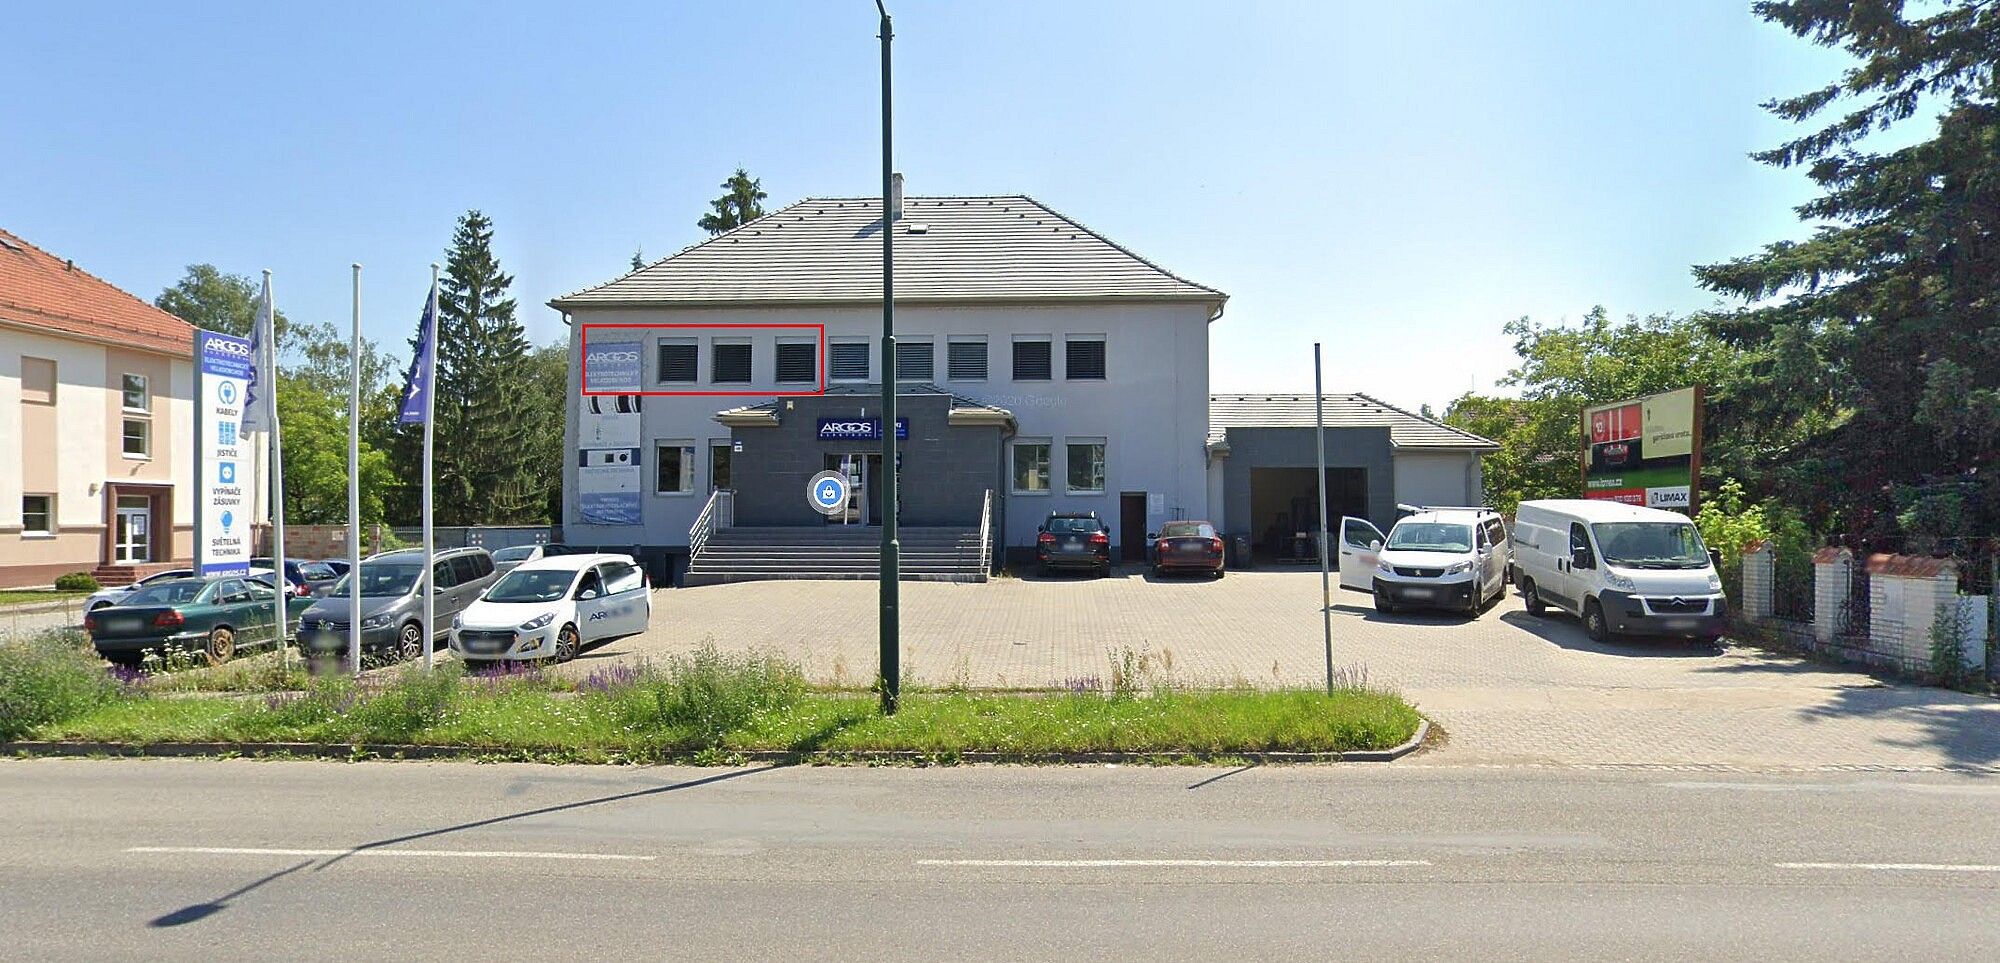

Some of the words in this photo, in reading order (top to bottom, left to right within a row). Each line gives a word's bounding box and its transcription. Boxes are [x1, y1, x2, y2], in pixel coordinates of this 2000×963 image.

[205, 338, 248, 357] ARGOS
[821, 422, 872, 432] ARGOS
[211, 548, 241, 556] TECHNIKA
